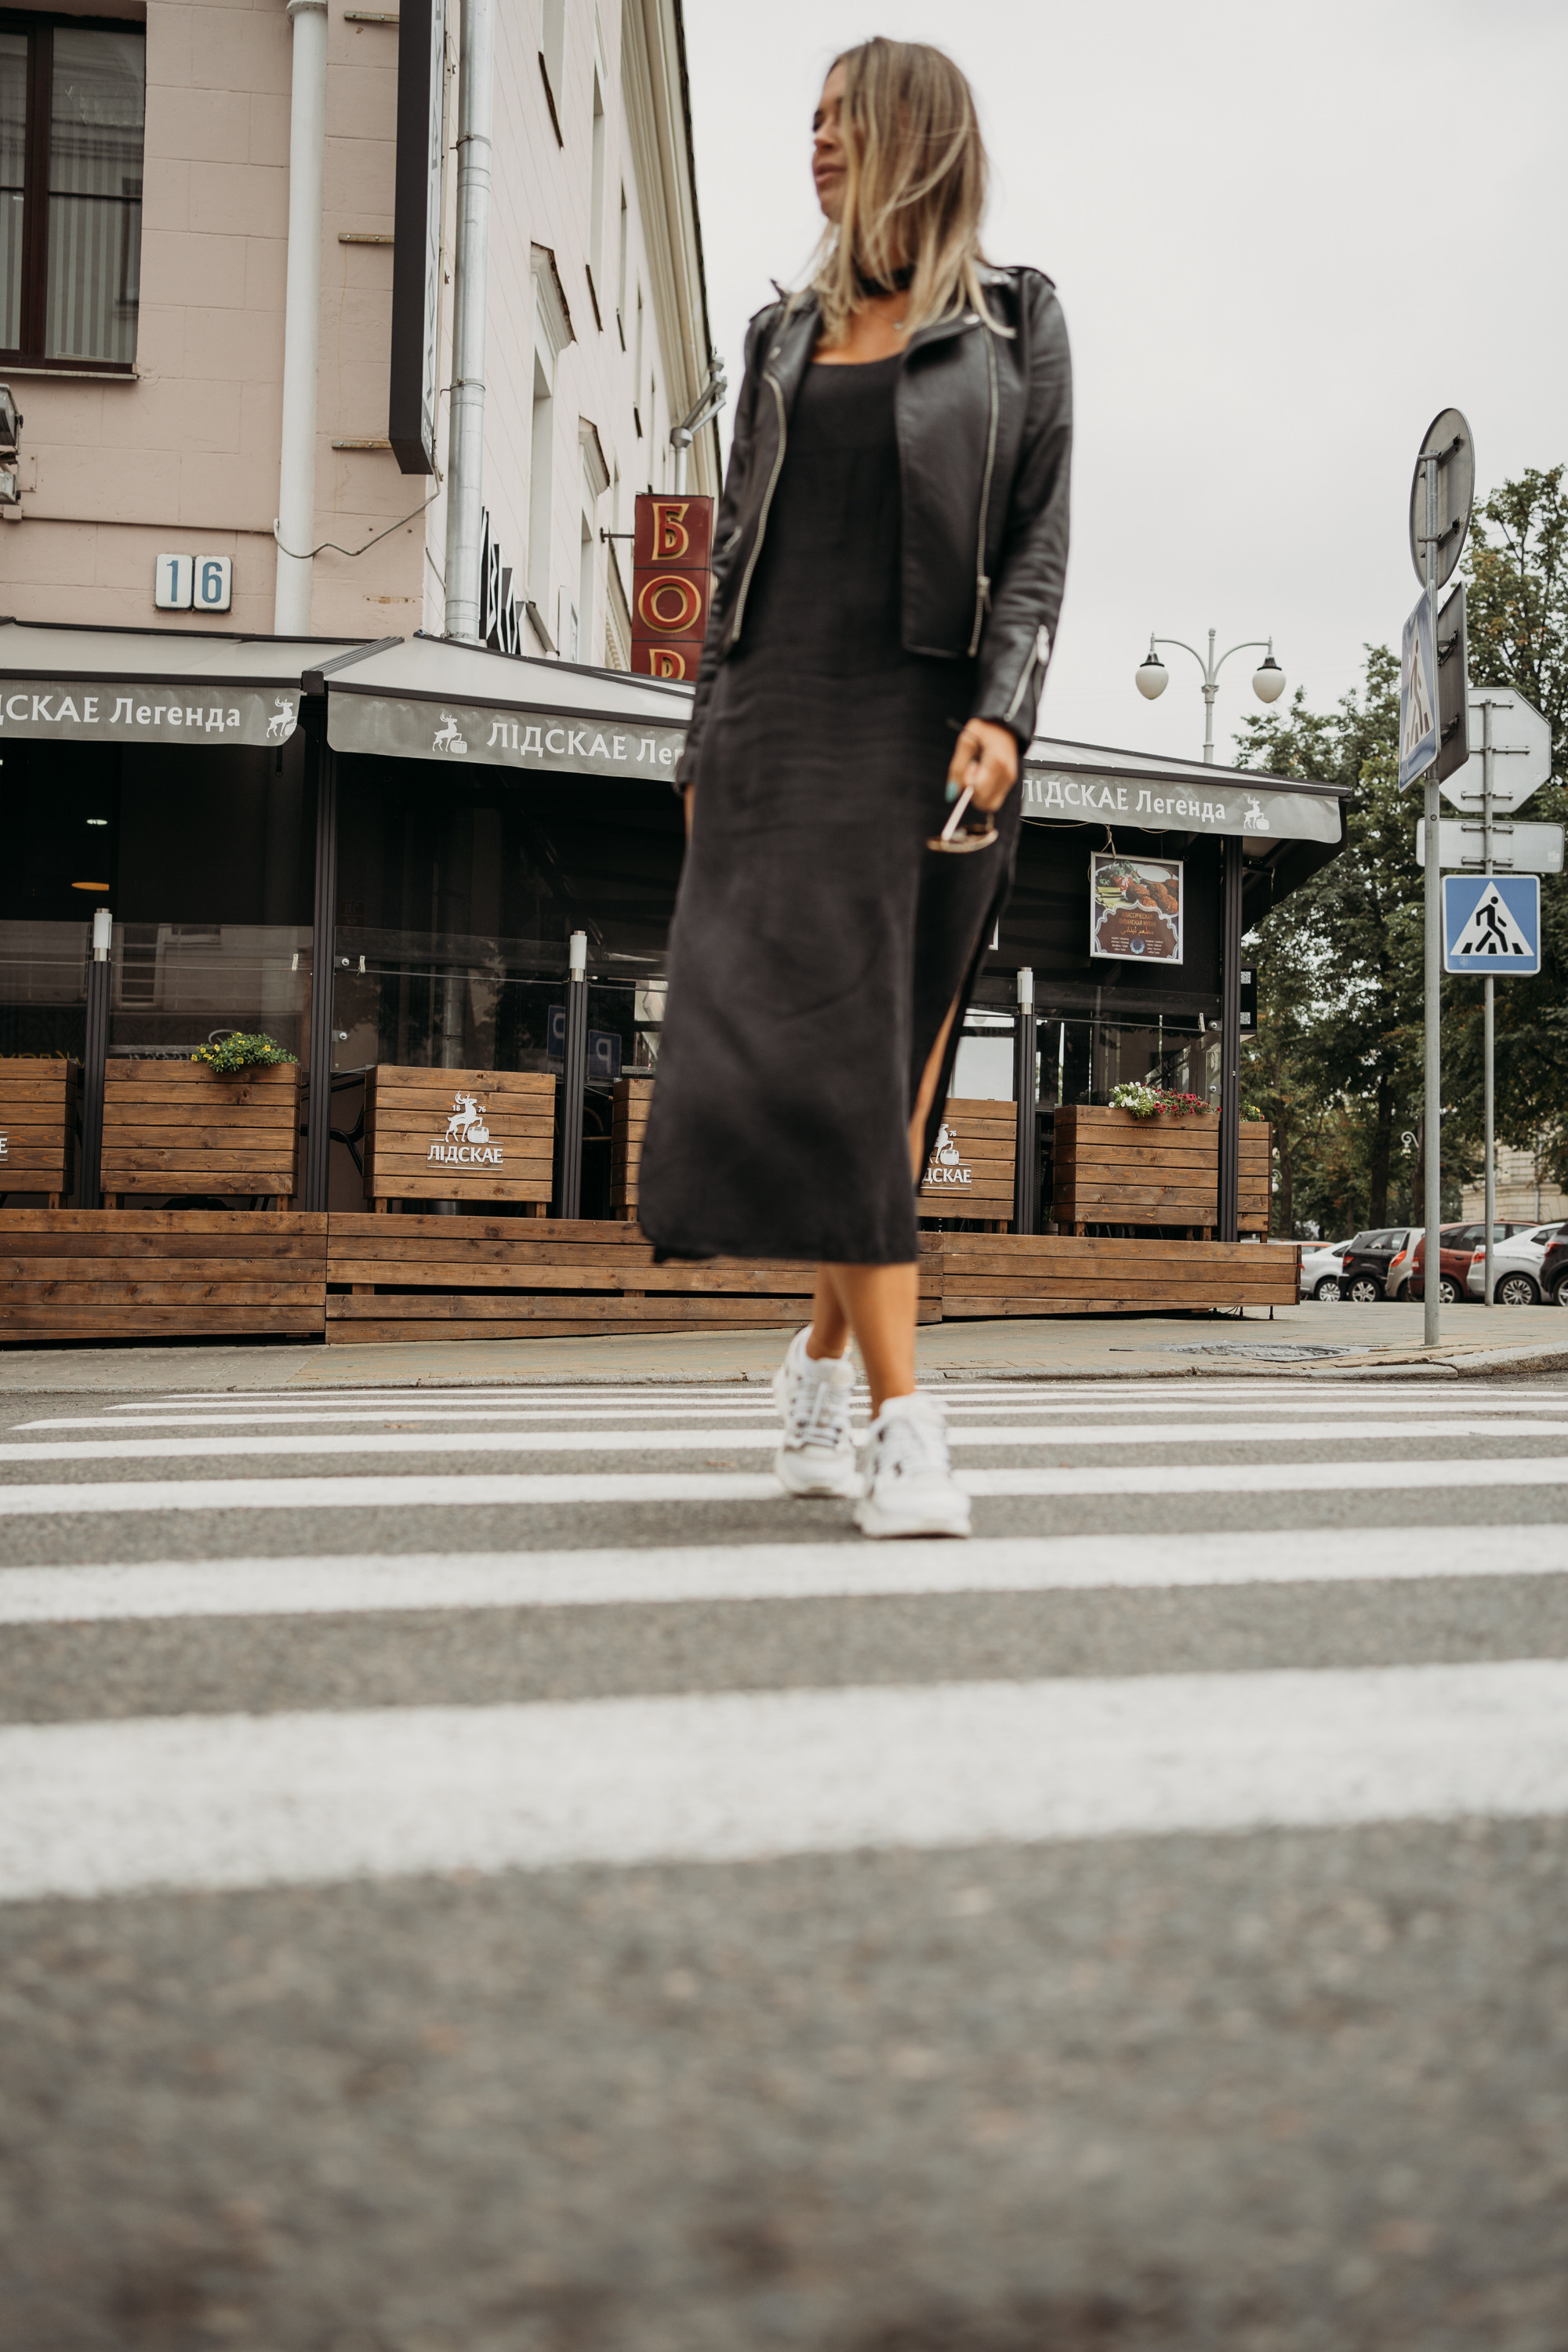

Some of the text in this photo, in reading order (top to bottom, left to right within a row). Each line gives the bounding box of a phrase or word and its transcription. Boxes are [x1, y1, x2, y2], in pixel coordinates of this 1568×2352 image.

[166, 560, 223, 603] 16
[0, 694, 241, 732] СКАЕ Легенда
[487, 721, 628, 759] ЛІДСКАЕ
[1135, 789, 1226, 823] Легенда
[427, 1145, 504, 1164] ЛІДСКАЕ
